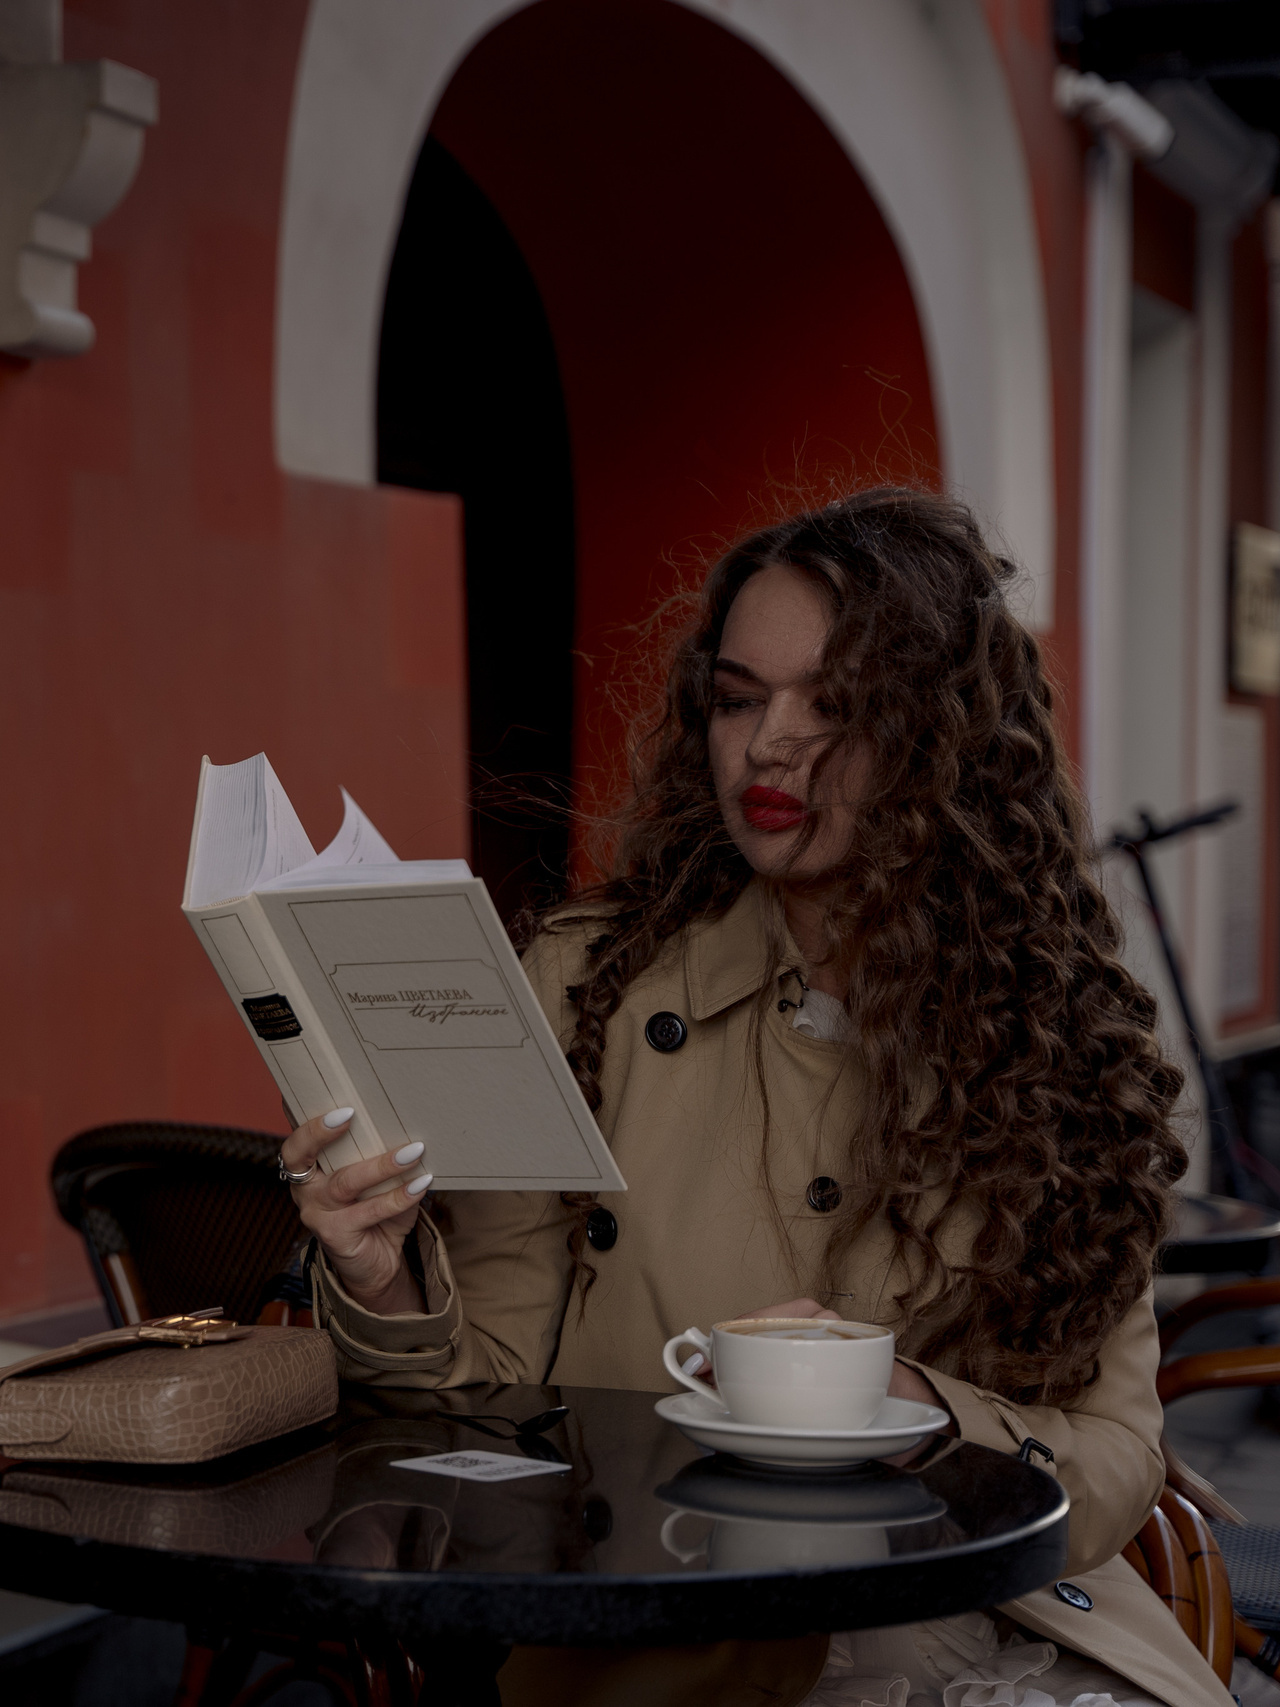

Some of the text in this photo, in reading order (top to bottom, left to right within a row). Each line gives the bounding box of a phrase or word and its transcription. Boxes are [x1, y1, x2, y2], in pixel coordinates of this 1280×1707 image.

[347, 989, 473, 1006] Марина ЦВЕТАЕВА
[409, 1002, 508, 1024] Избранное
